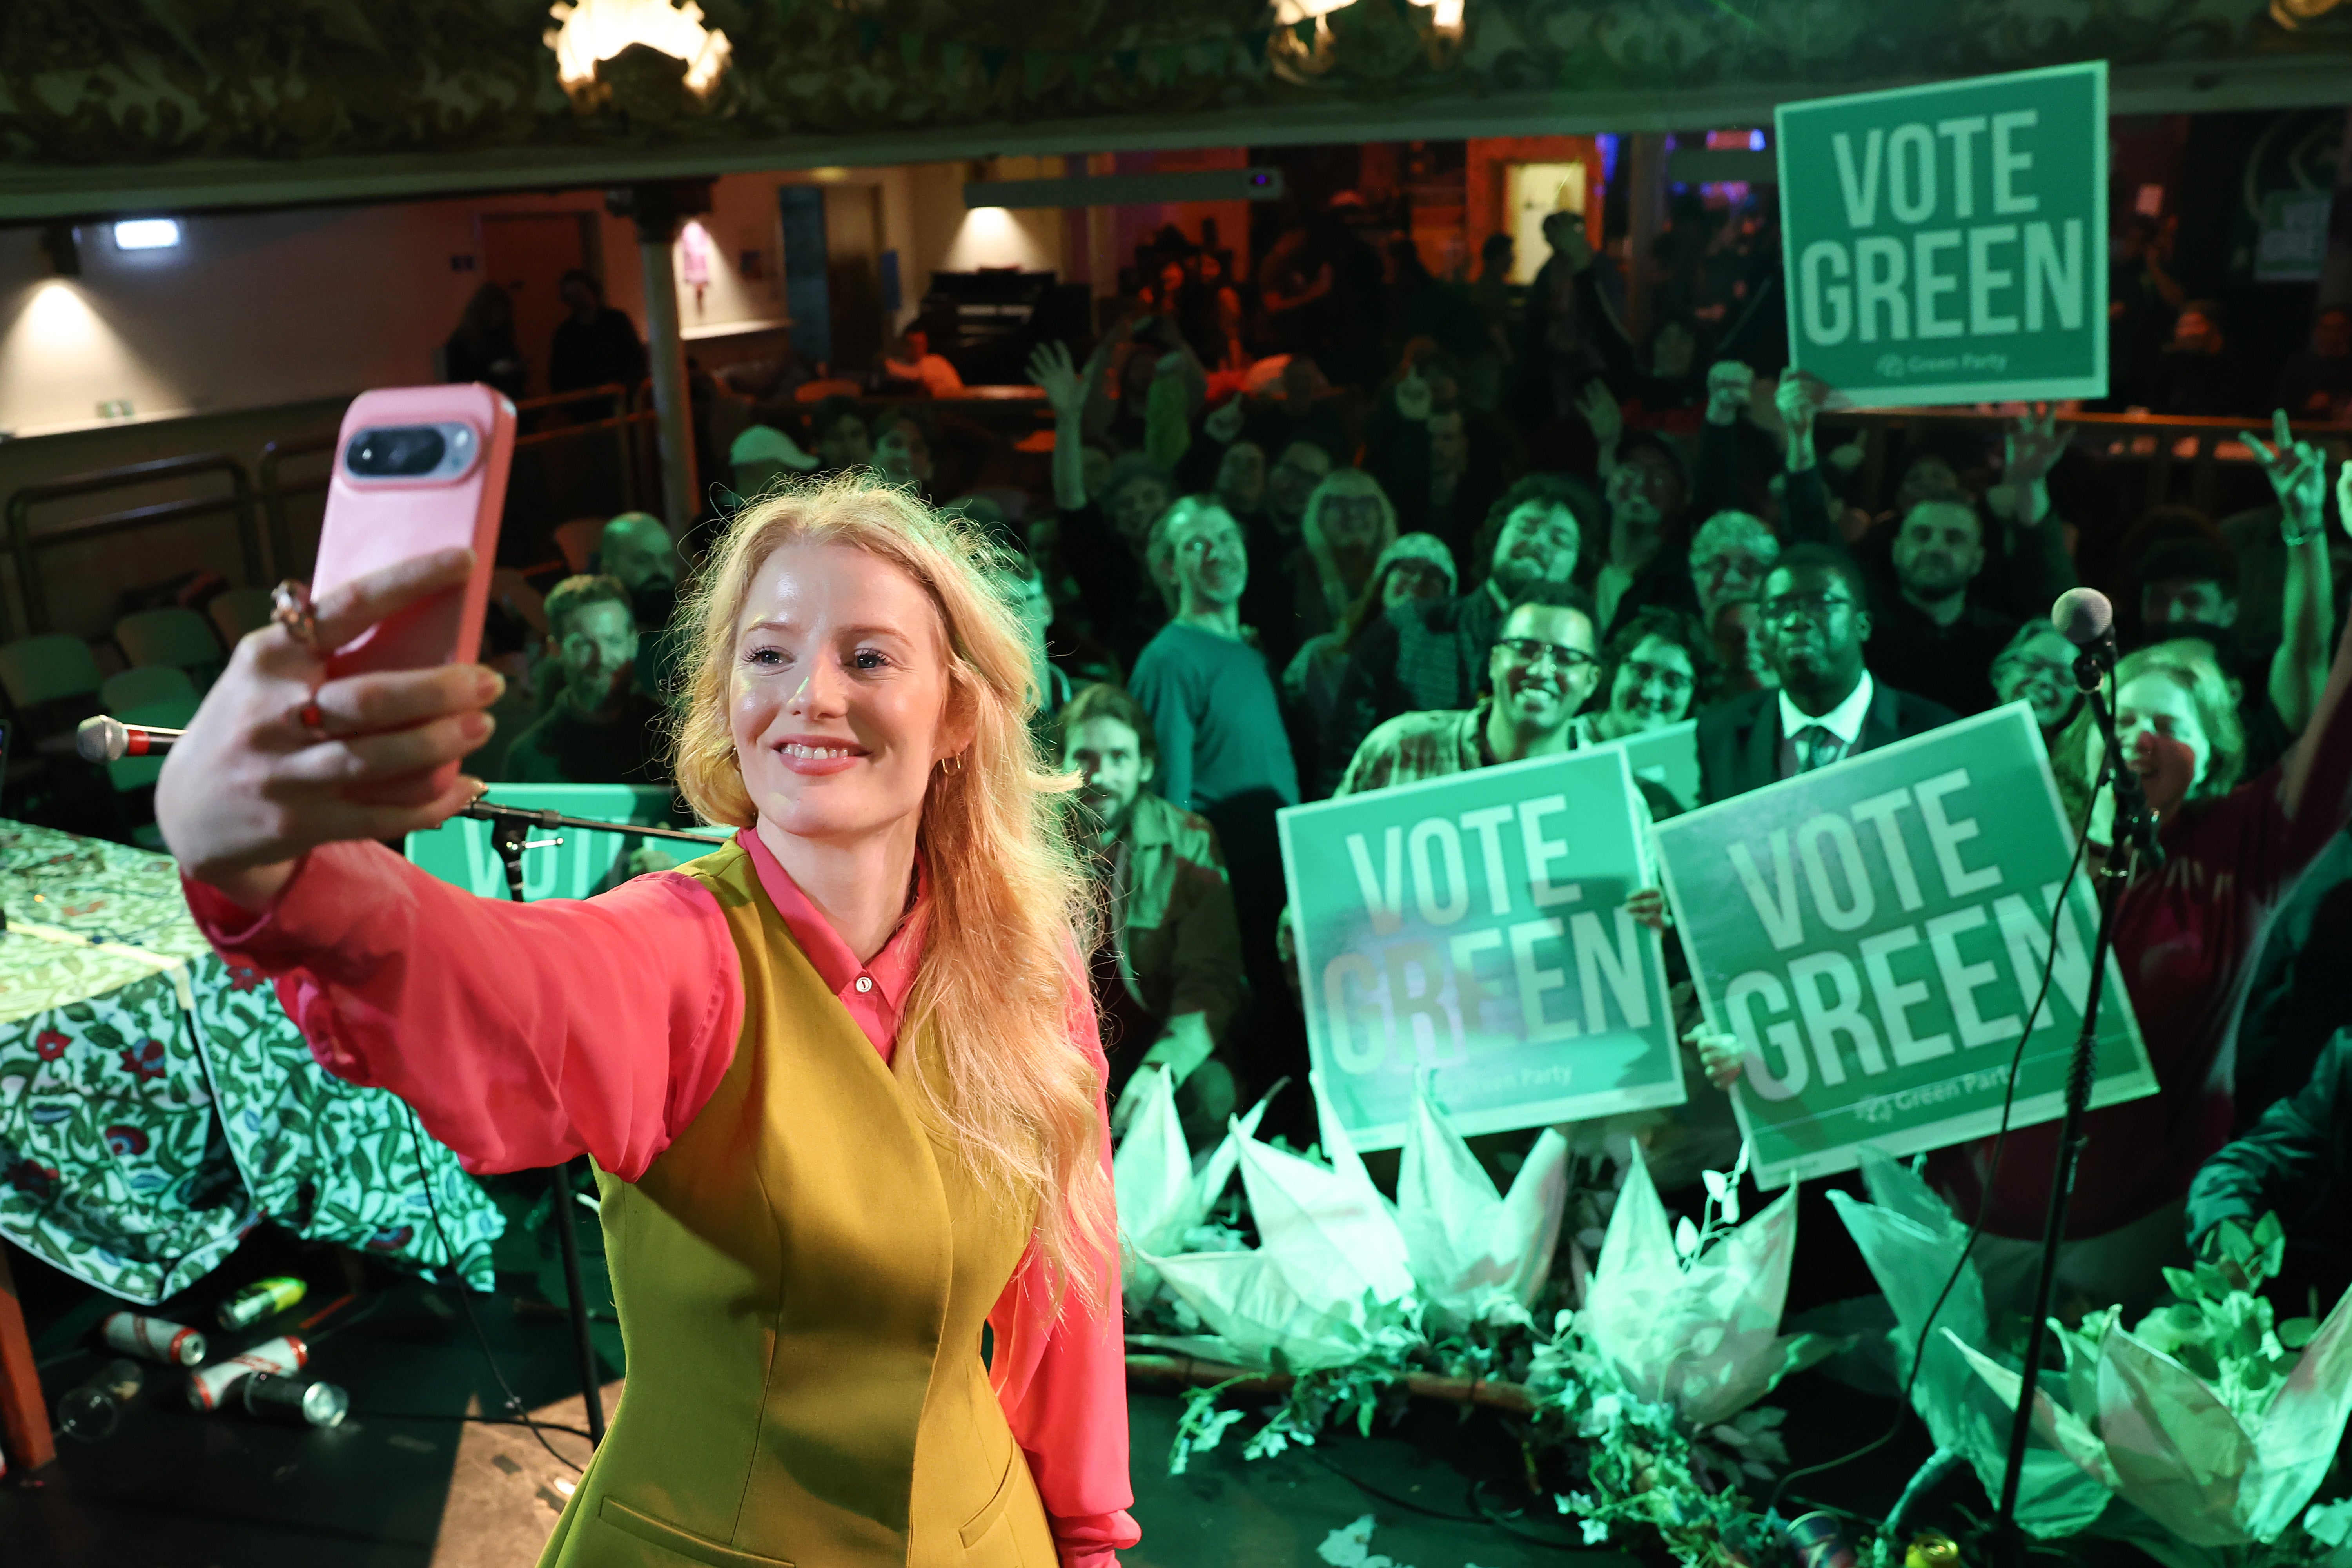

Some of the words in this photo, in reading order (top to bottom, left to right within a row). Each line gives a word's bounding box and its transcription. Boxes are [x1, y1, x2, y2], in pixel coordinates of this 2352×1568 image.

[1832, 109, 2038, 229] VOTE
[1800, 217, 2083, 347] GREEN
[1345, 794, 1582, 936] VOTE
[1727, 768, 2003, 951] VOTE
[1323, 906, 1652, 1075] GREEN
[1725, 880, 2105, 1102] GREEN
[1895, 1080, 1960, 1110] Green
